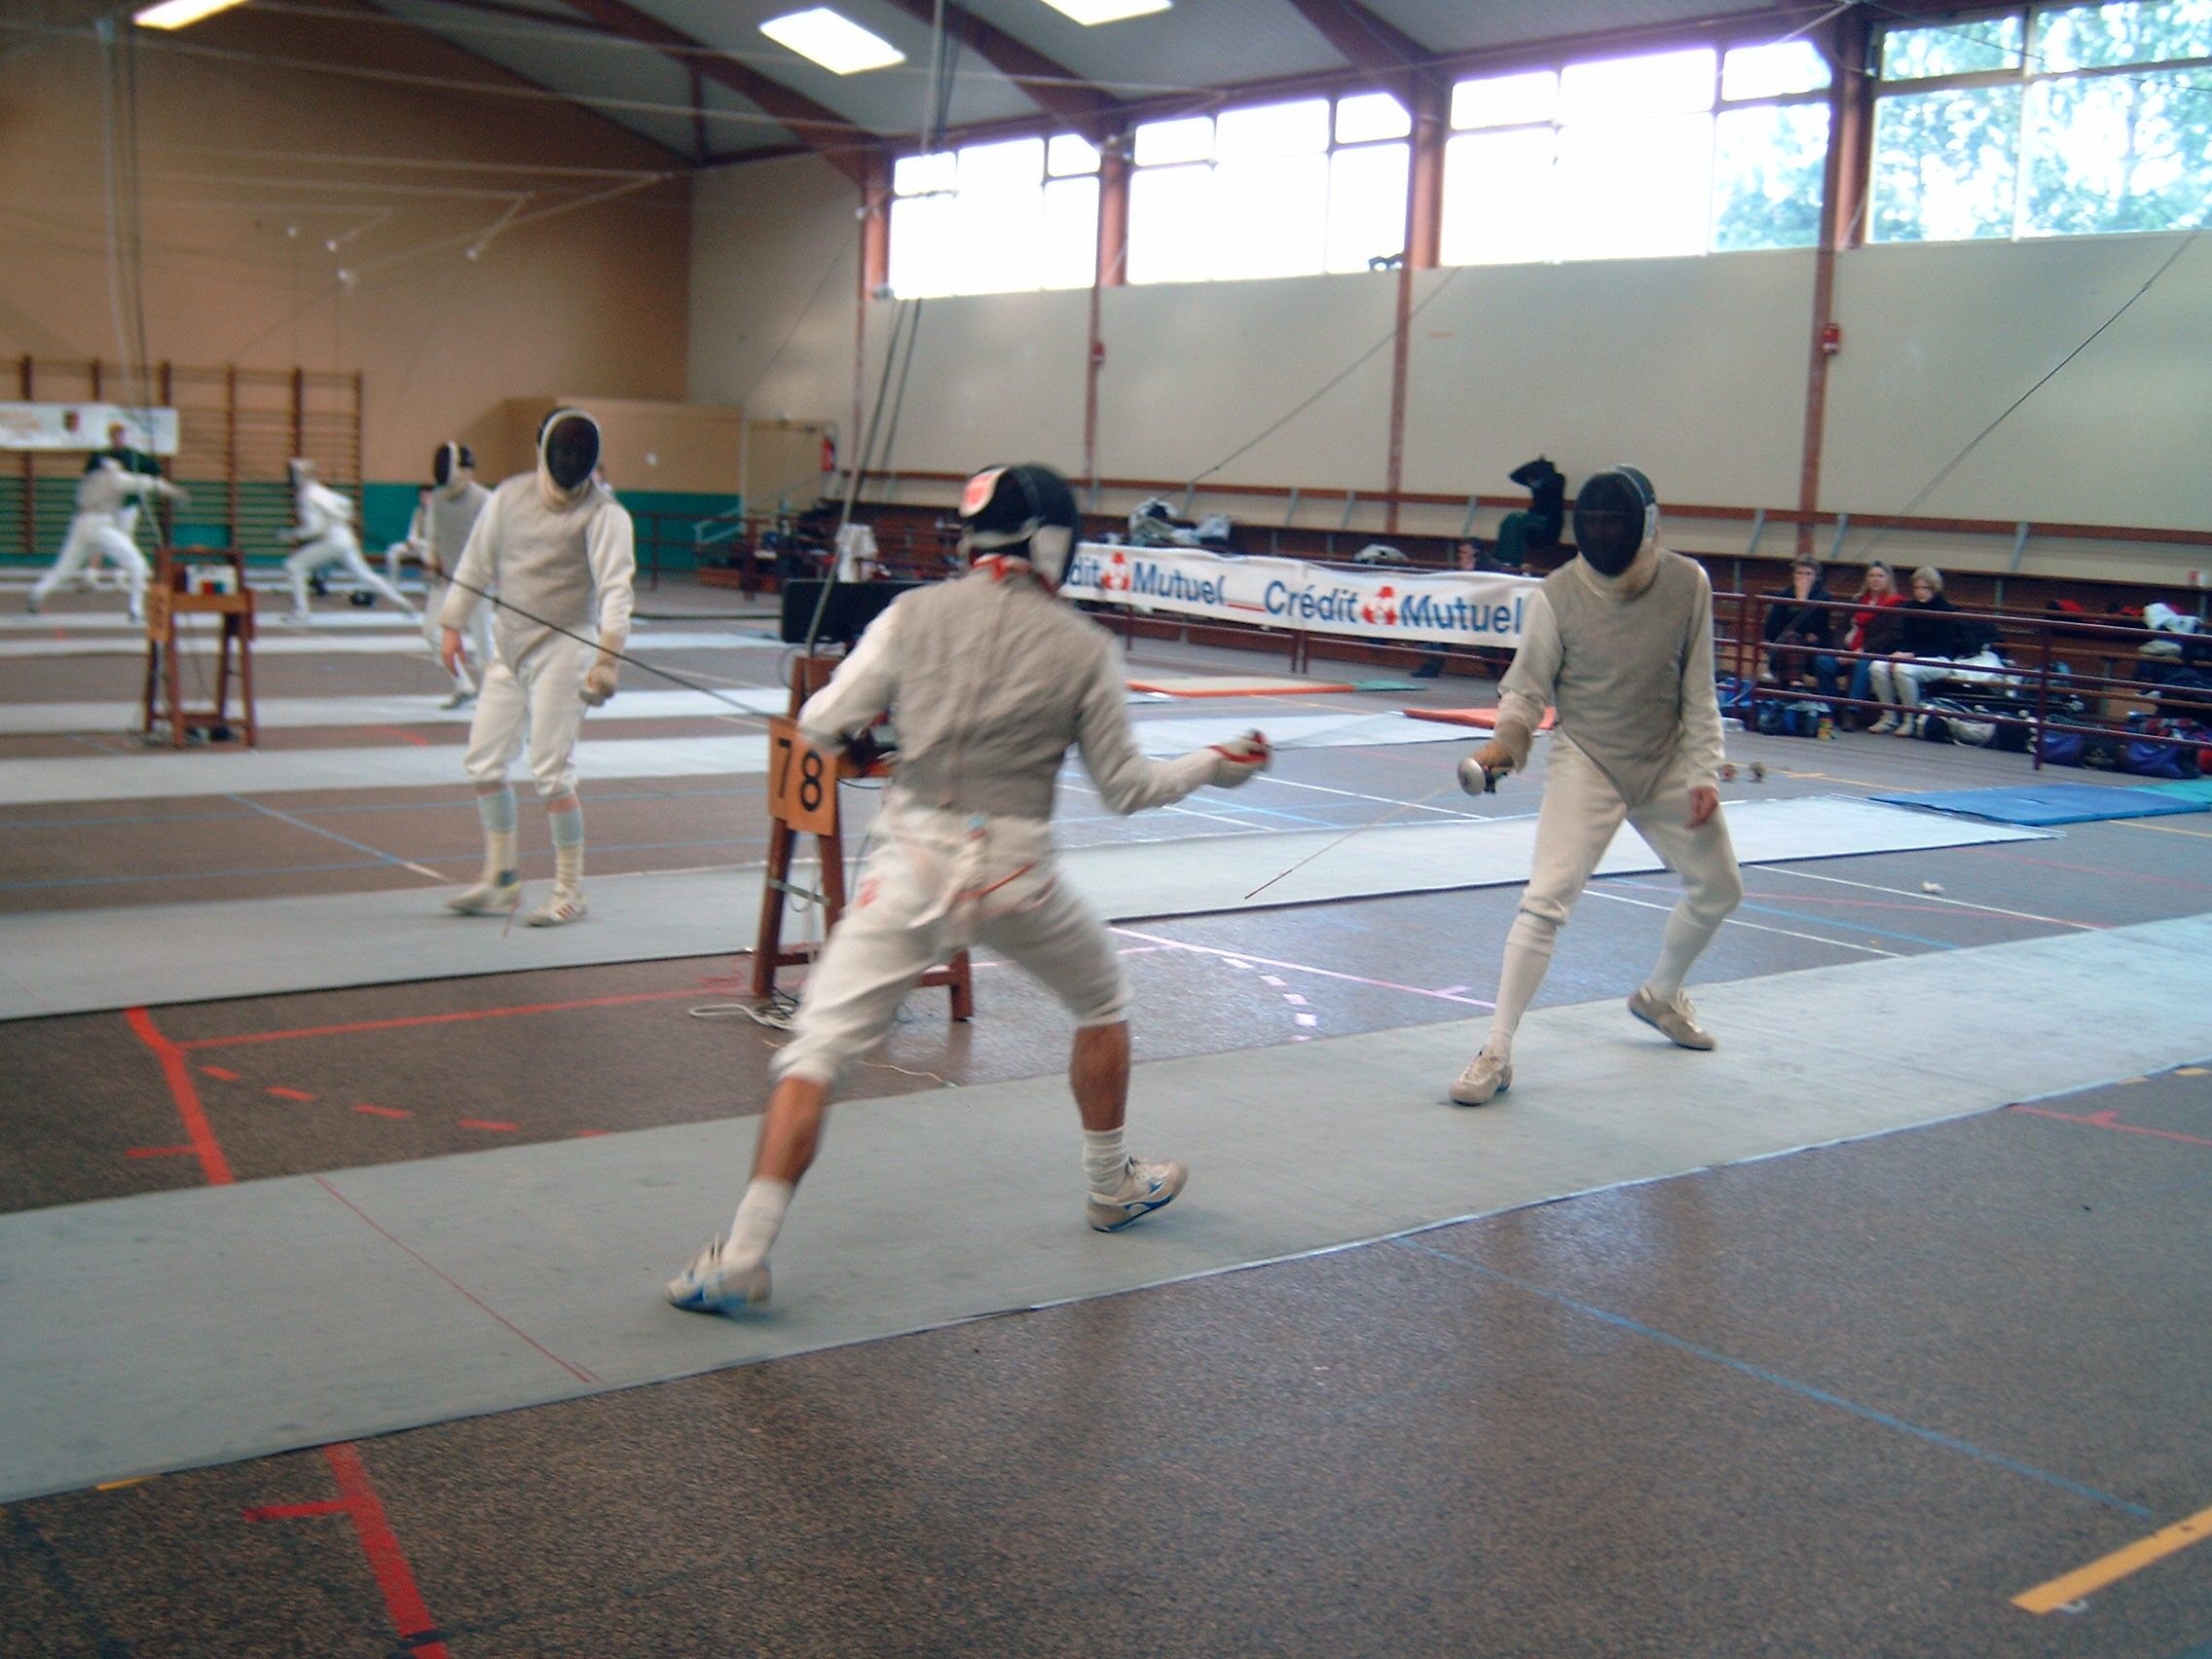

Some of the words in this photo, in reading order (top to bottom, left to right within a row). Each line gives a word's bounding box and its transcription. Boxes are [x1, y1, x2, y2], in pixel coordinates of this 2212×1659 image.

[1132, 562, 1226, 606] Mutuel
[1265, 580, 1358, 623] Crédit
[1400, 594, 1523, 634] Mutuel
